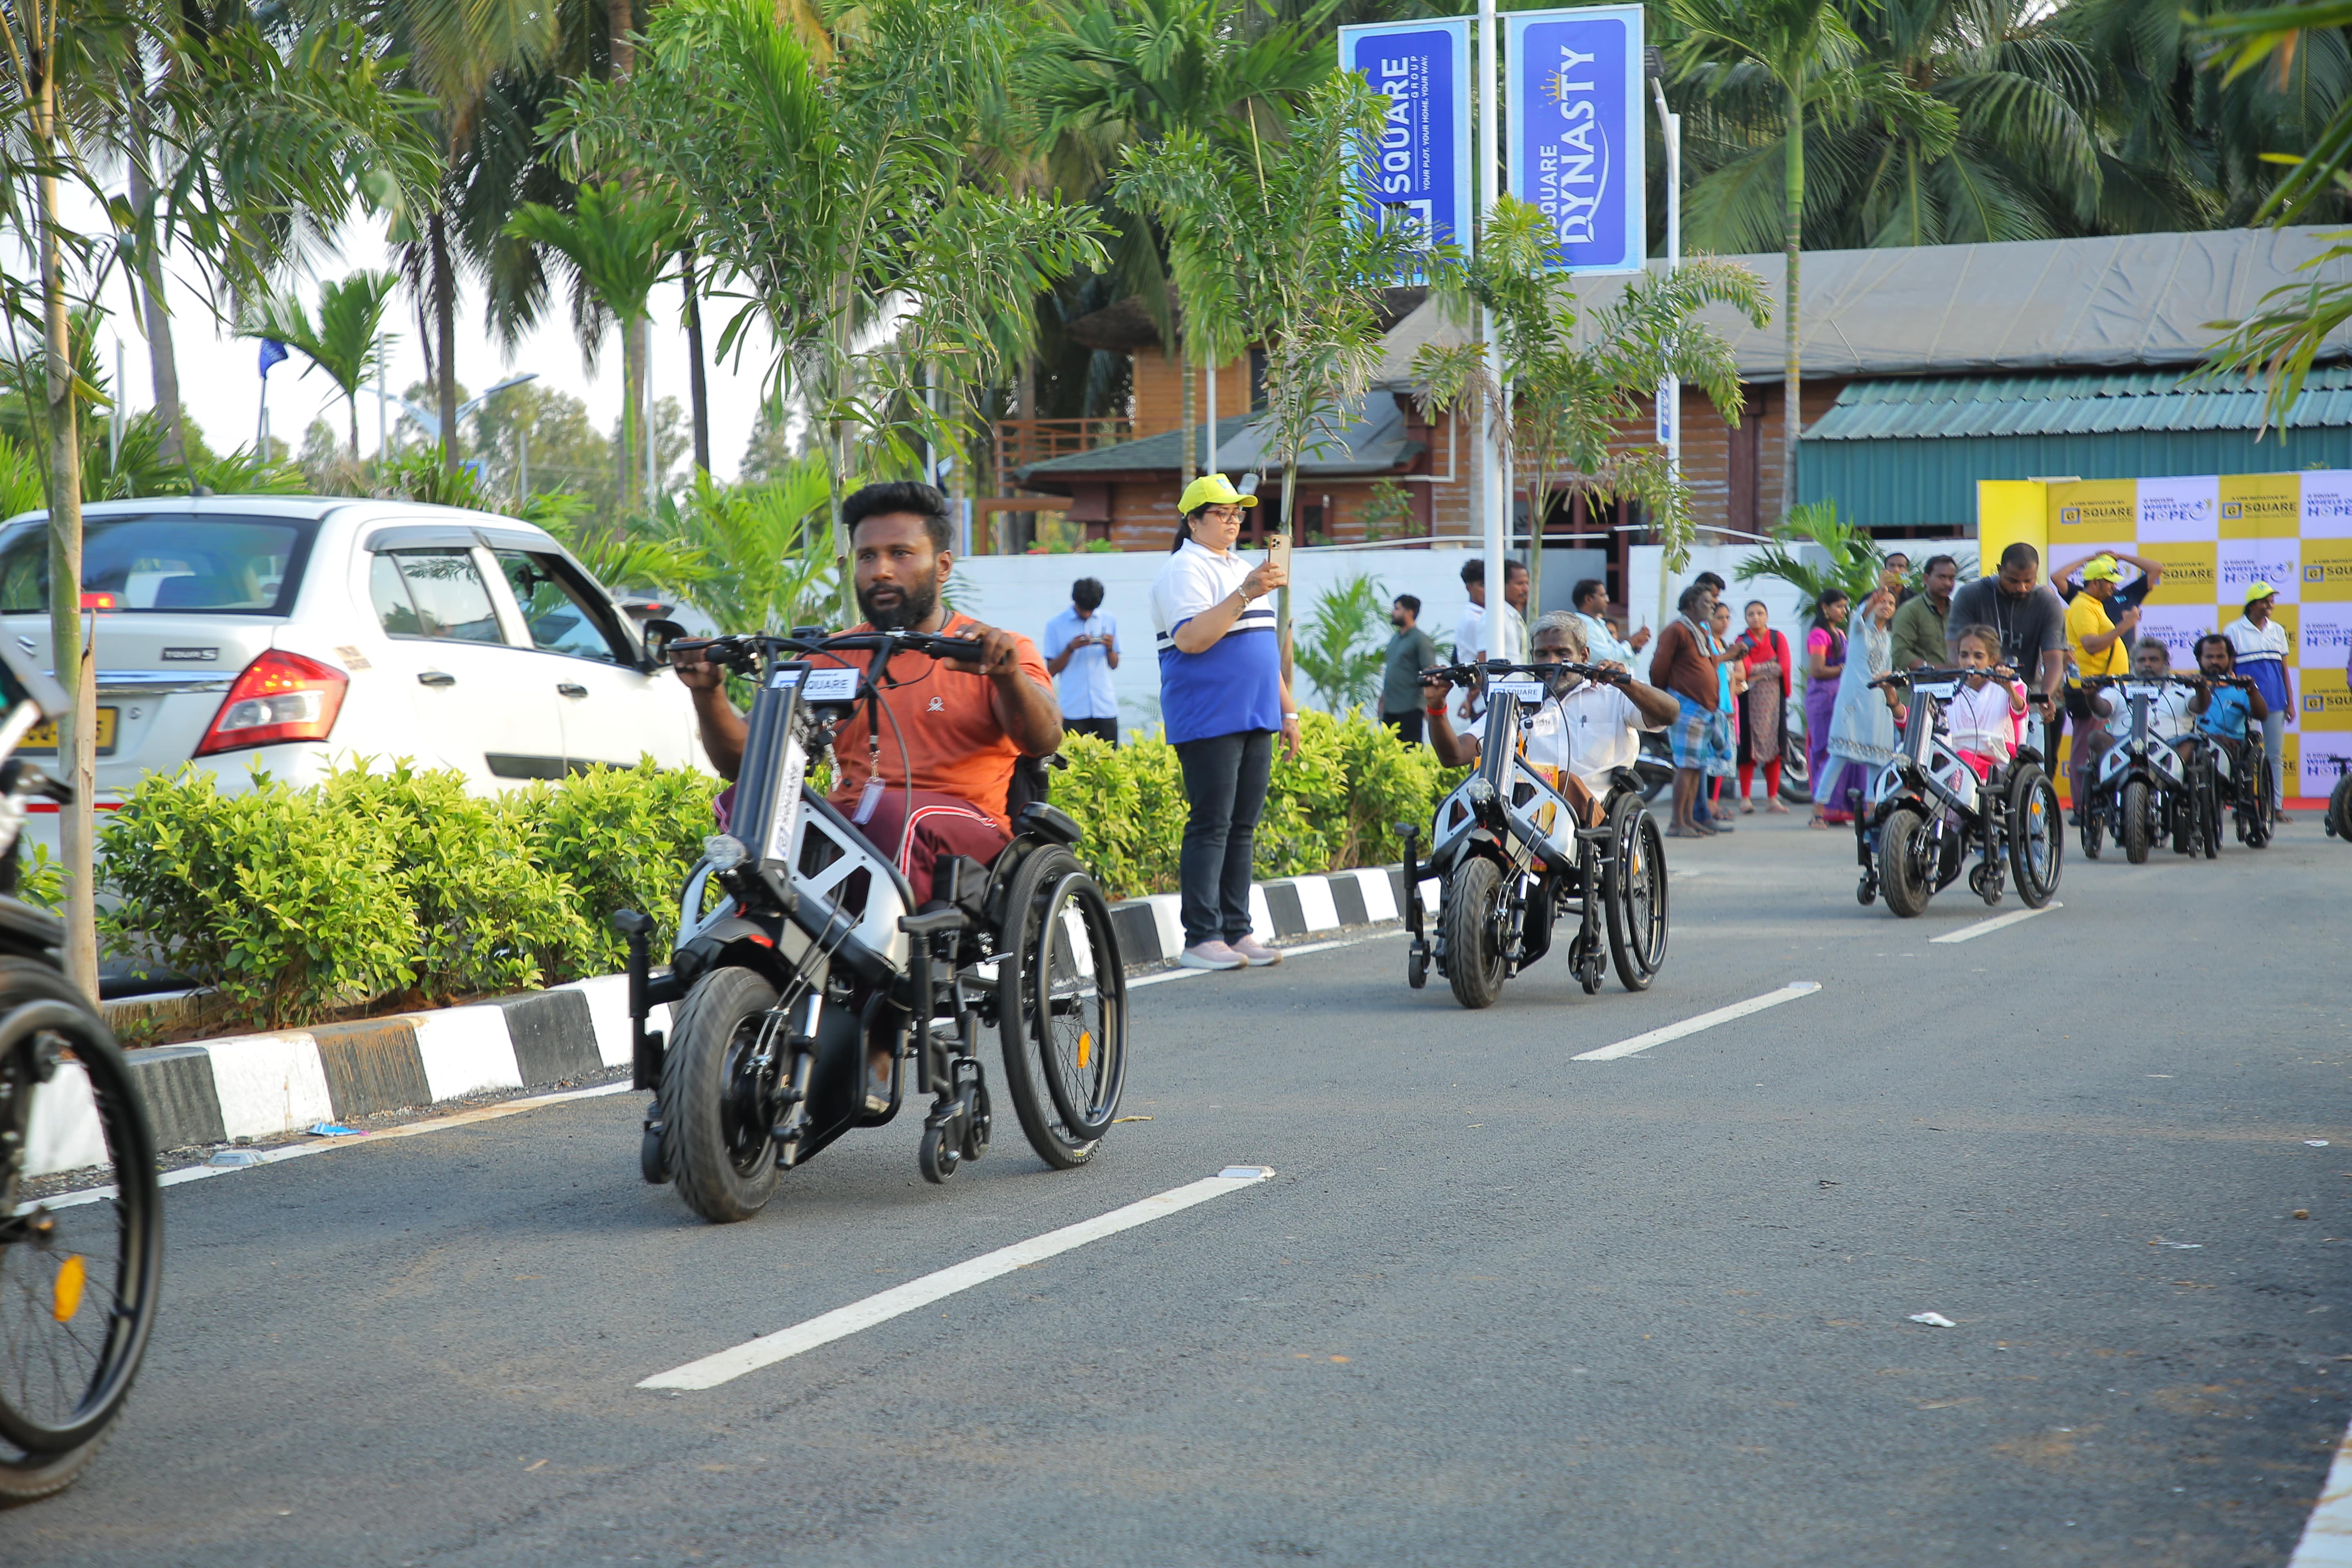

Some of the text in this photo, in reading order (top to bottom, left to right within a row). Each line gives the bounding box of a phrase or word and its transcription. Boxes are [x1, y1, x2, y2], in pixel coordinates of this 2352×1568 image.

[1410, 56, 1419, 98] GROUP
[1381, 57, 1411, 194] SQUARE
[1561, 45, 1595, 243] DYNASTY
[2083, 507, 2134, 518] SQUARE
[2244, 502, 2297, 512] SQUARE
[2308, 506, 2352, 517] HOPE
[2144, 510, 2189, 521] HOPE
[2163, 568, 2214, 579] SQUARE
[2225, 573, 2269, 583] HOPE
[2307, 637, 2352, 647] HOPE
[201, 649, 216, 659] S
[806, 679, 849, 690] QUARE
